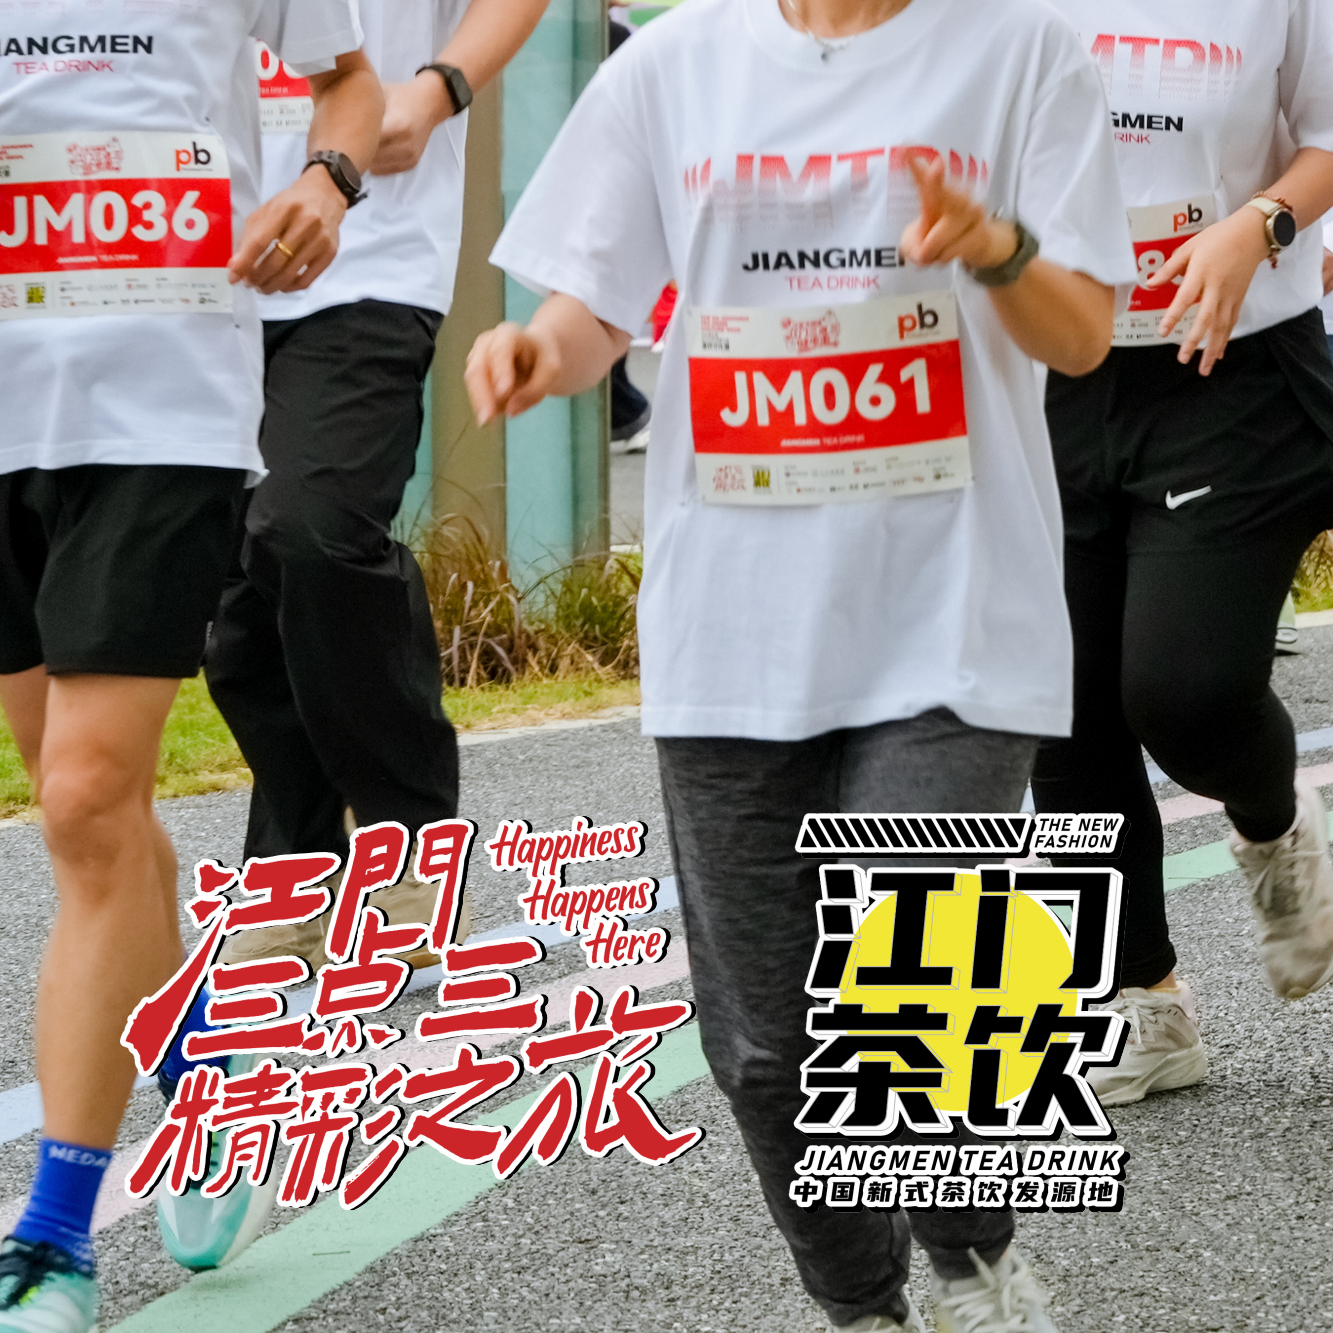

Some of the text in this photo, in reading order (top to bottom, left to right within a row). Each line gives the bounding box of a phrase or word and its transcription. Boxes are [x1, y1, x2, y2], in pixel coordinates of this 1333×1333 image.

[0, 34, 155, 57] ANGMEN
[12, 58, 115, 76] TEA DRINK
[0, 188, 210, 249] JM036
[742, 246, 905, 273] JIANGME
[1136, 249, 1187, 292] 8
[785, 274, 881, 292] TEA DRINK
[719, 357, 932, 428] JM061
